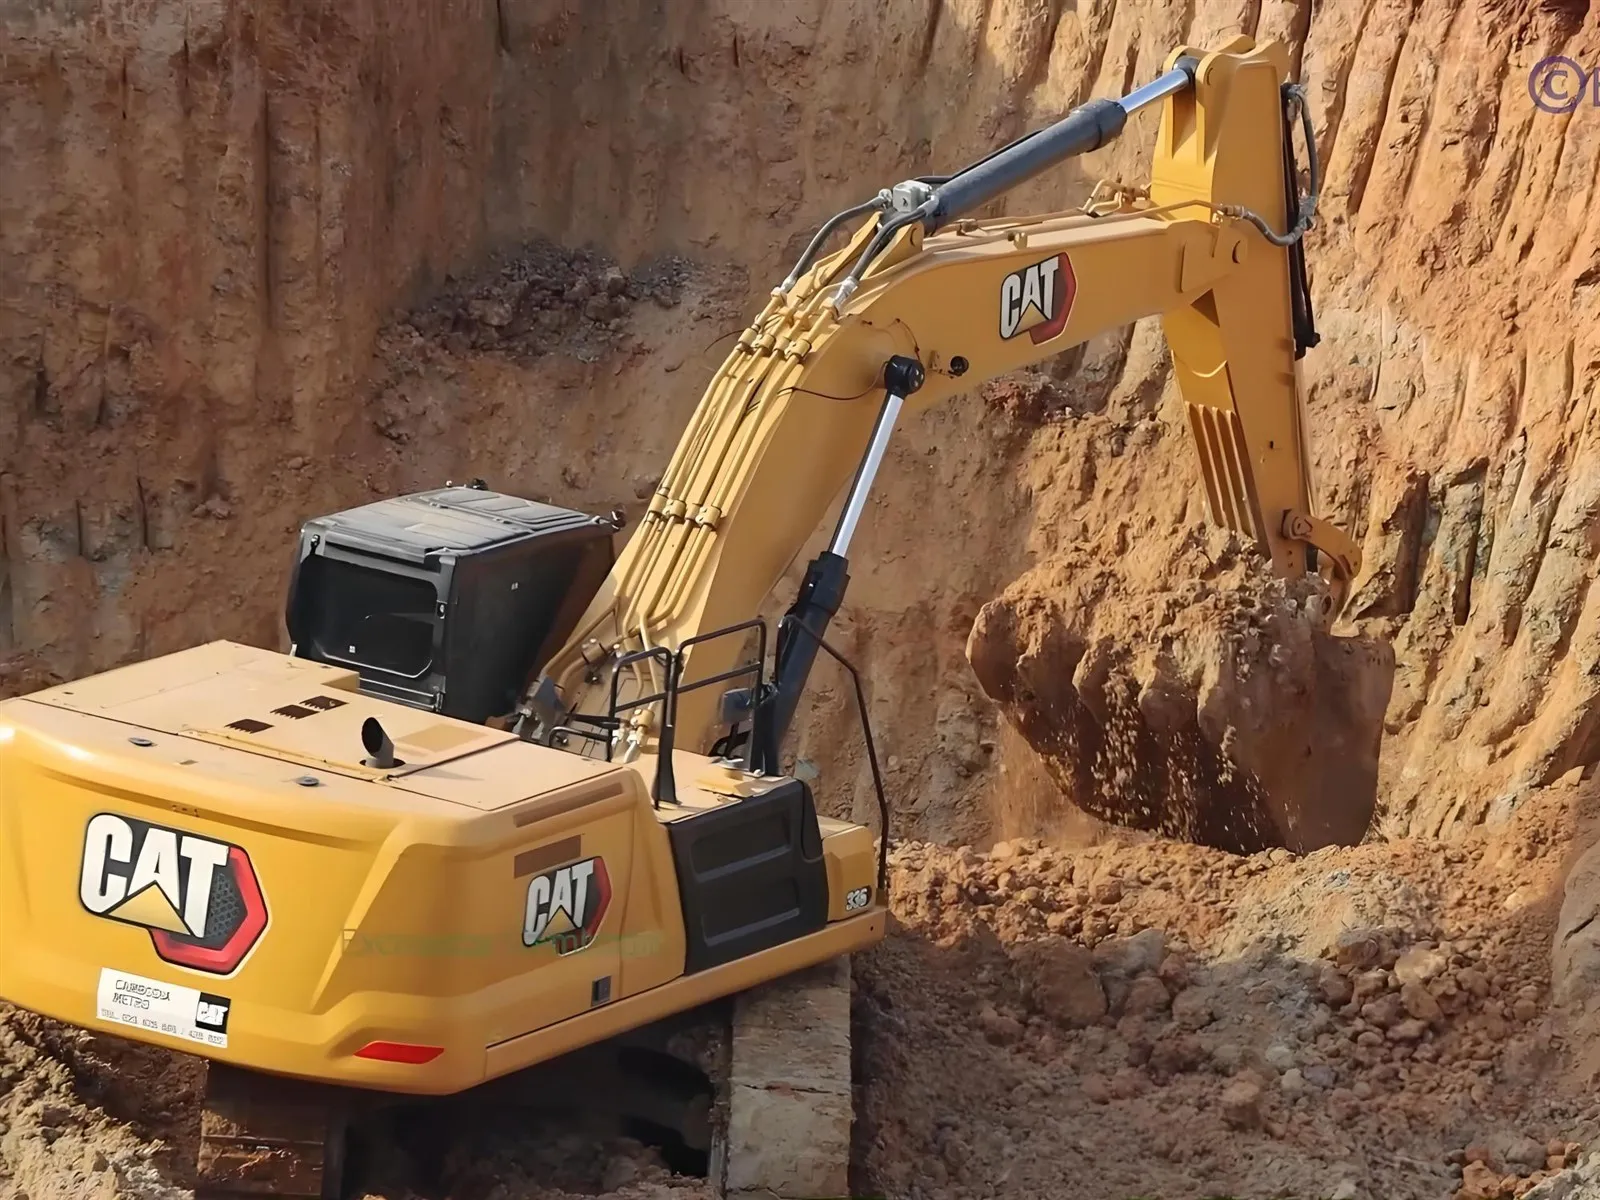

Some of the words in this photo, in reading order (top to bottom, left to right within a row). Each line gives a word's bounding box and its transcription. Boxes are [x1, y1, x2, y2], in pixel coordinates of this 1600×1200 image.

[1000, 256, 1059, 339] CAT
[80, 813, 230, 938] CAT
[523, 859, 594, 946] CAT
